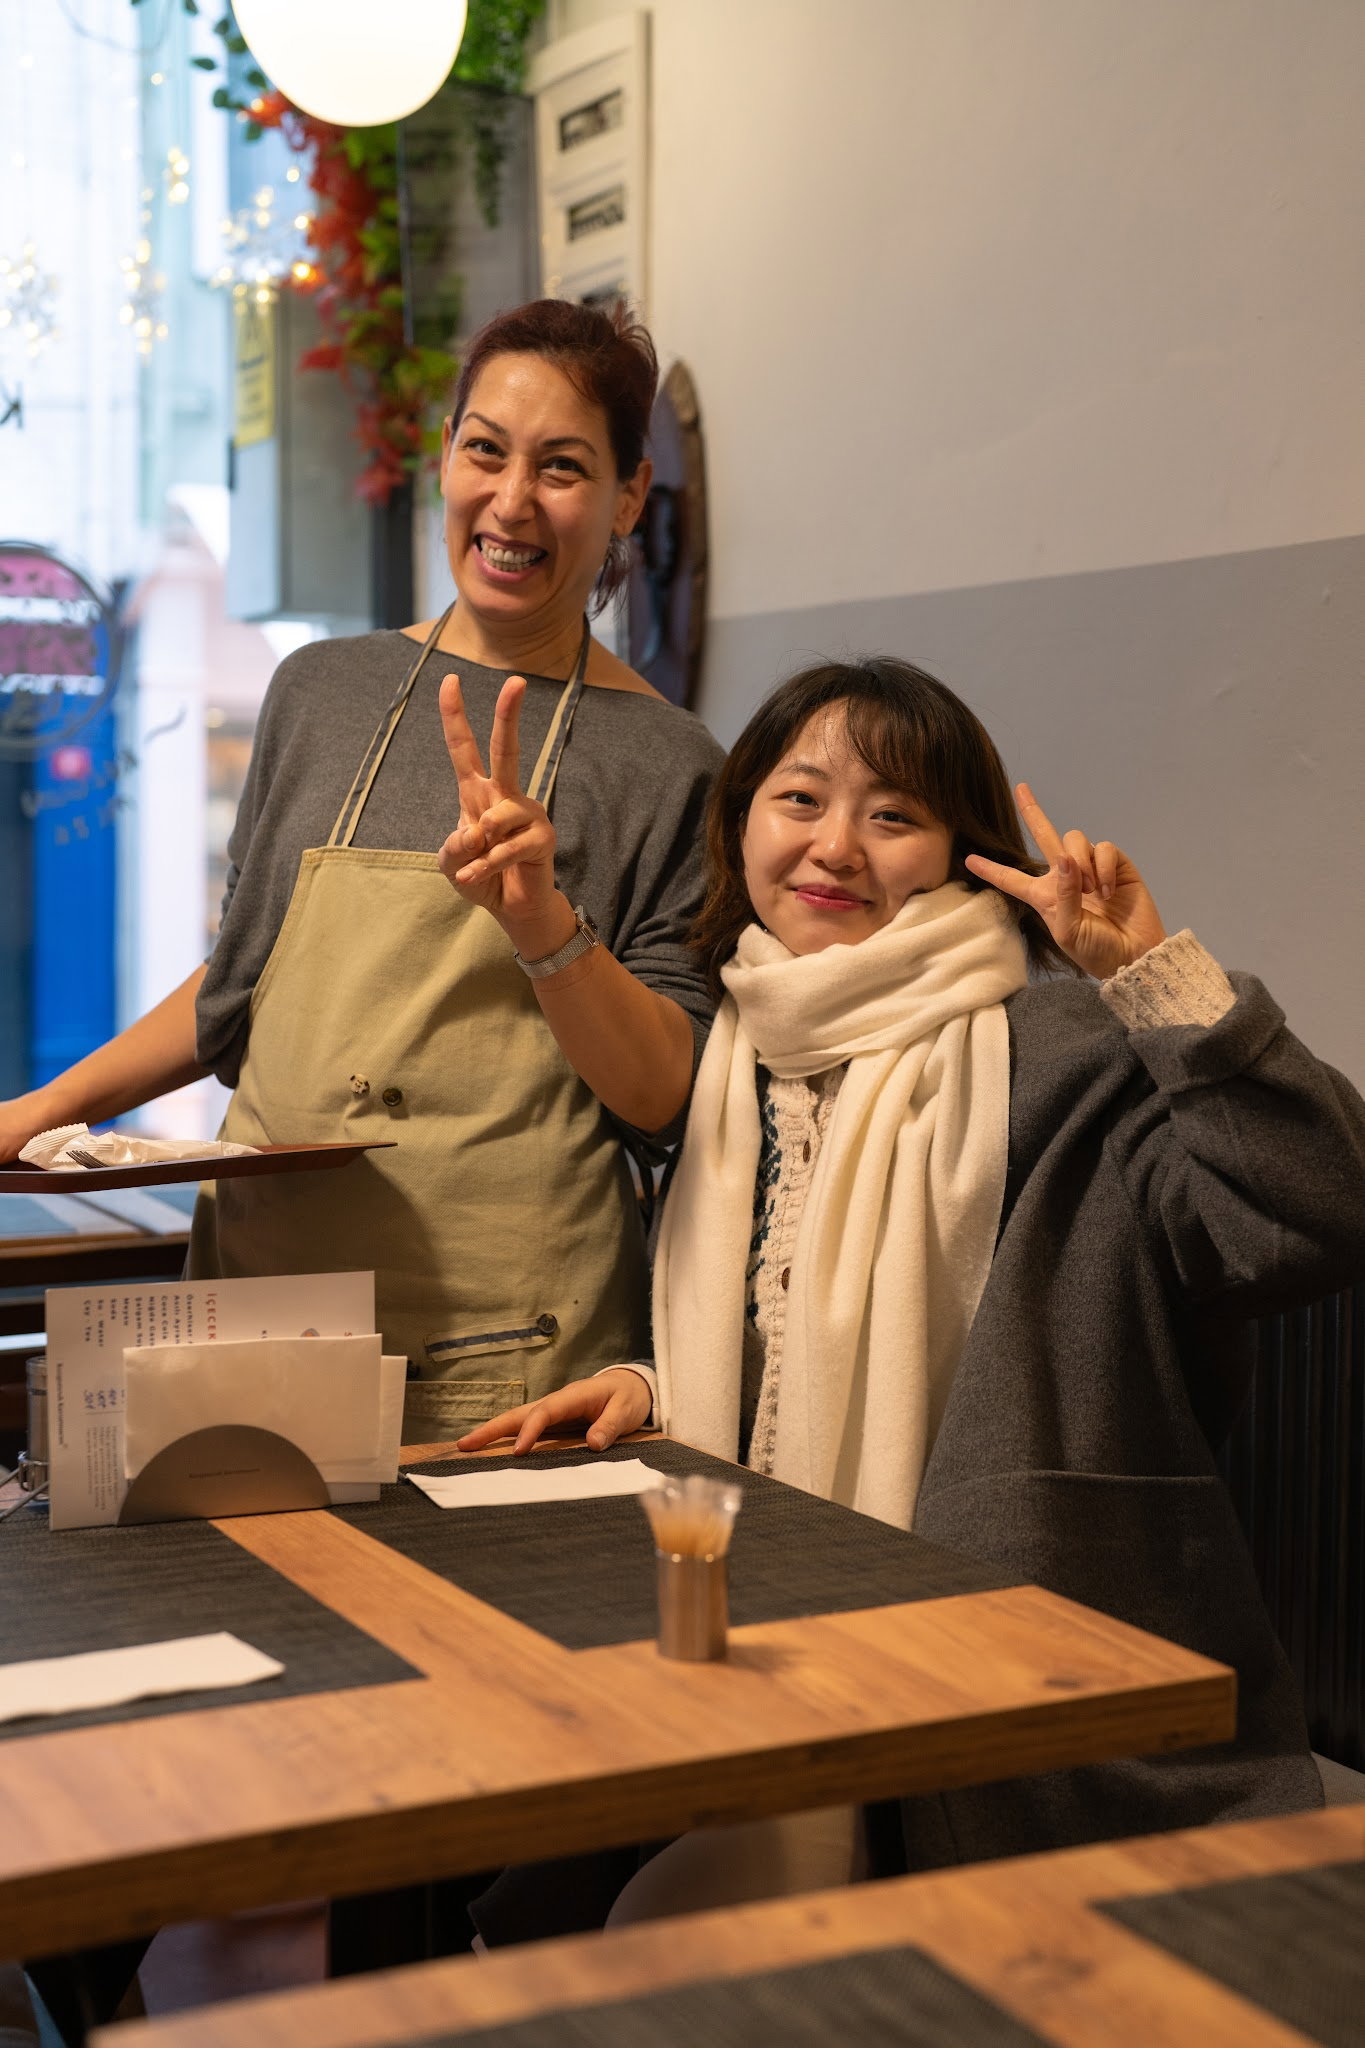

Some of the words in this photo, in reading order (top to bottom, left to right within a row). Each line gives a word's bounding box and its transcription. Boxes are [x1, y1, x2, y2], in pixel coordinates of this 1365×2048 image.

[83, 1300, 92, 1316] Çay
[110, 1298, 118, 1320] Soda
[161, 1295, 169, 1317] Coca
[161, 1320, 169, 1340] Cola
